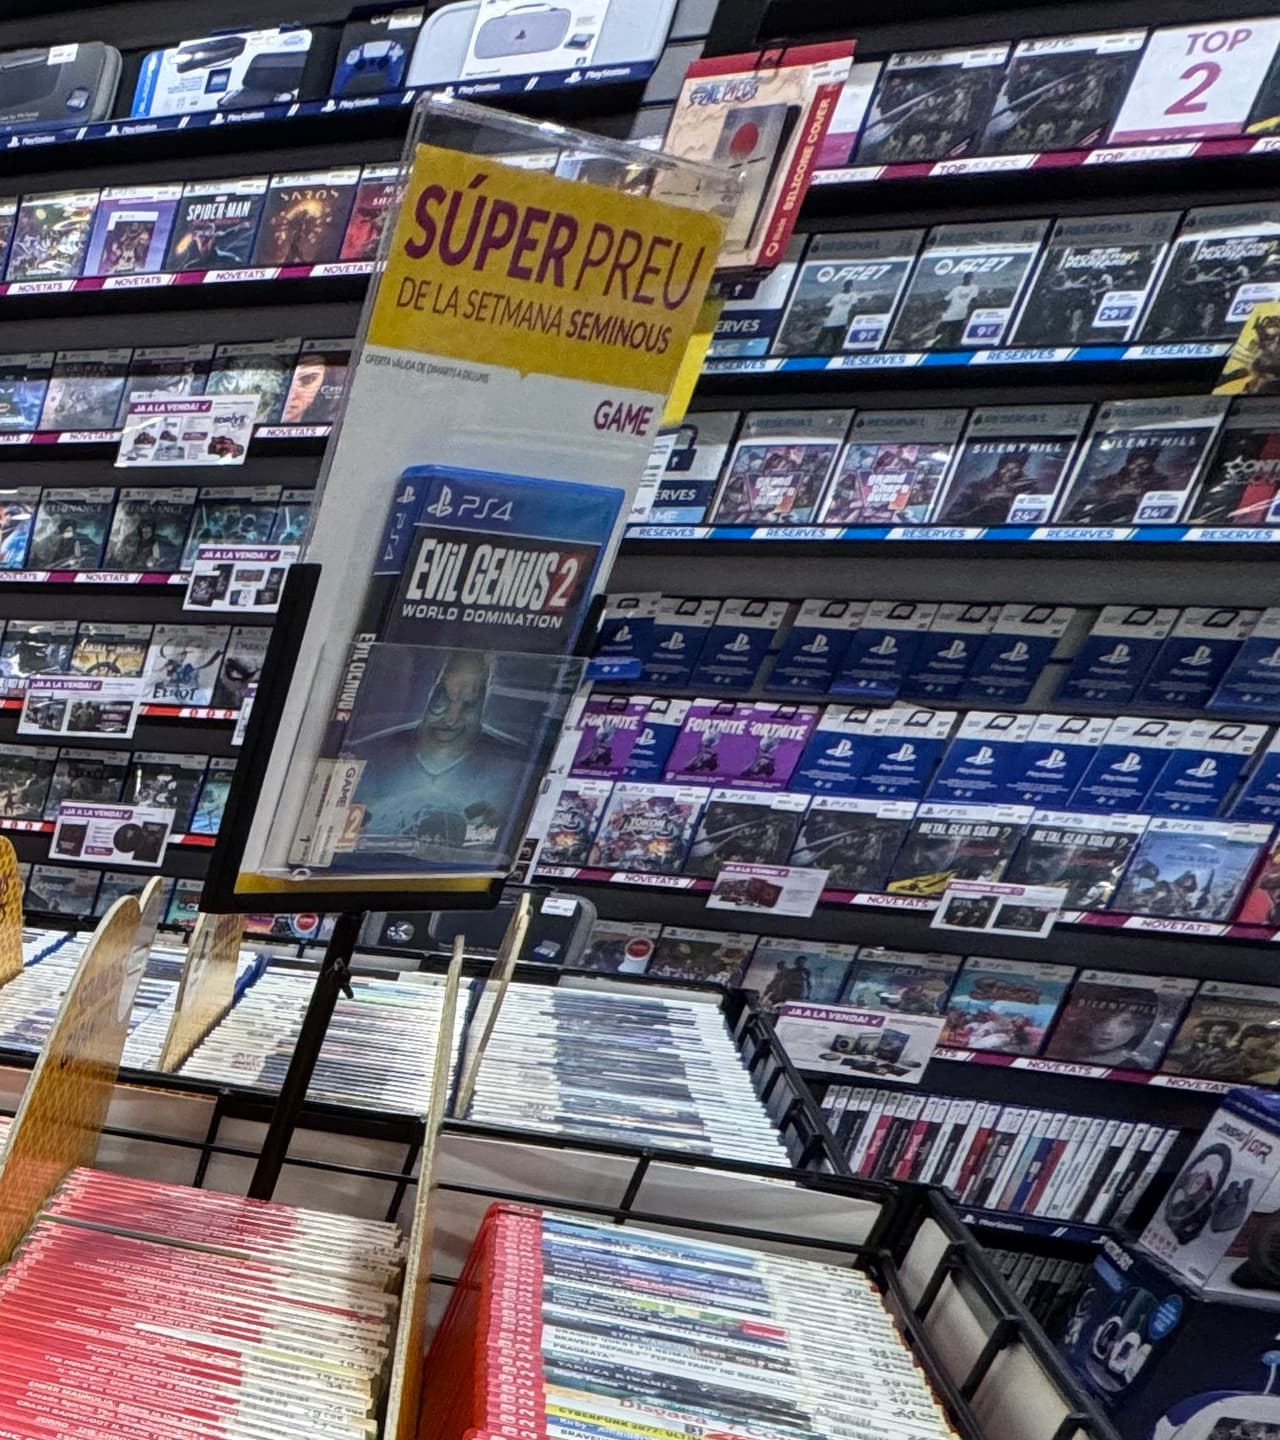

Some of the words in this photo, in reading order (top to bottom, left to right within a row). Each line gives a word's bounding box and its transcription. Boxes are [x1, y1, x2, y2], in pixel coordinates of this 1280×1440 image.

[1185, 29, 1252, 56] TOP
[1163, 61, 1224, 116] 2
[404, 173, 579, 288] SÚPER
[574, 224, 705, 311] PREU
[114, 276, 163, 287] NOVETATS
[215, 269, 267, 280] NOVETATS
[396, 276, 430, 310] DE
[433, 289, 458, 315] LA
[463, 288, 564, 338] SETMANA
[565, 309, 672, 354] SEMINOUS
[986, 348, 1054, 361] RESERVES
[1141, 344, 1213, 356] RESERVES
[594, 400, 652, 436] GAME
[972, 441, 1026, 454] SILENT
[1030, 441, 1063, 454] HILL
[457, 495, 513, 521] PS4
[902, 529, 965, 539] RESERVES
[549, 557, 579, 607] 2
[402, 604, 458, 621] WORLD
[462, 607, 563, 629] DOMINATION
[685, 717, 745, 737] FORTNITE
[919, 822, 946, 836] METAL
[947, 823, 970, 837] GEAR
[1142, 922, 1211, 934] NOVETATS
